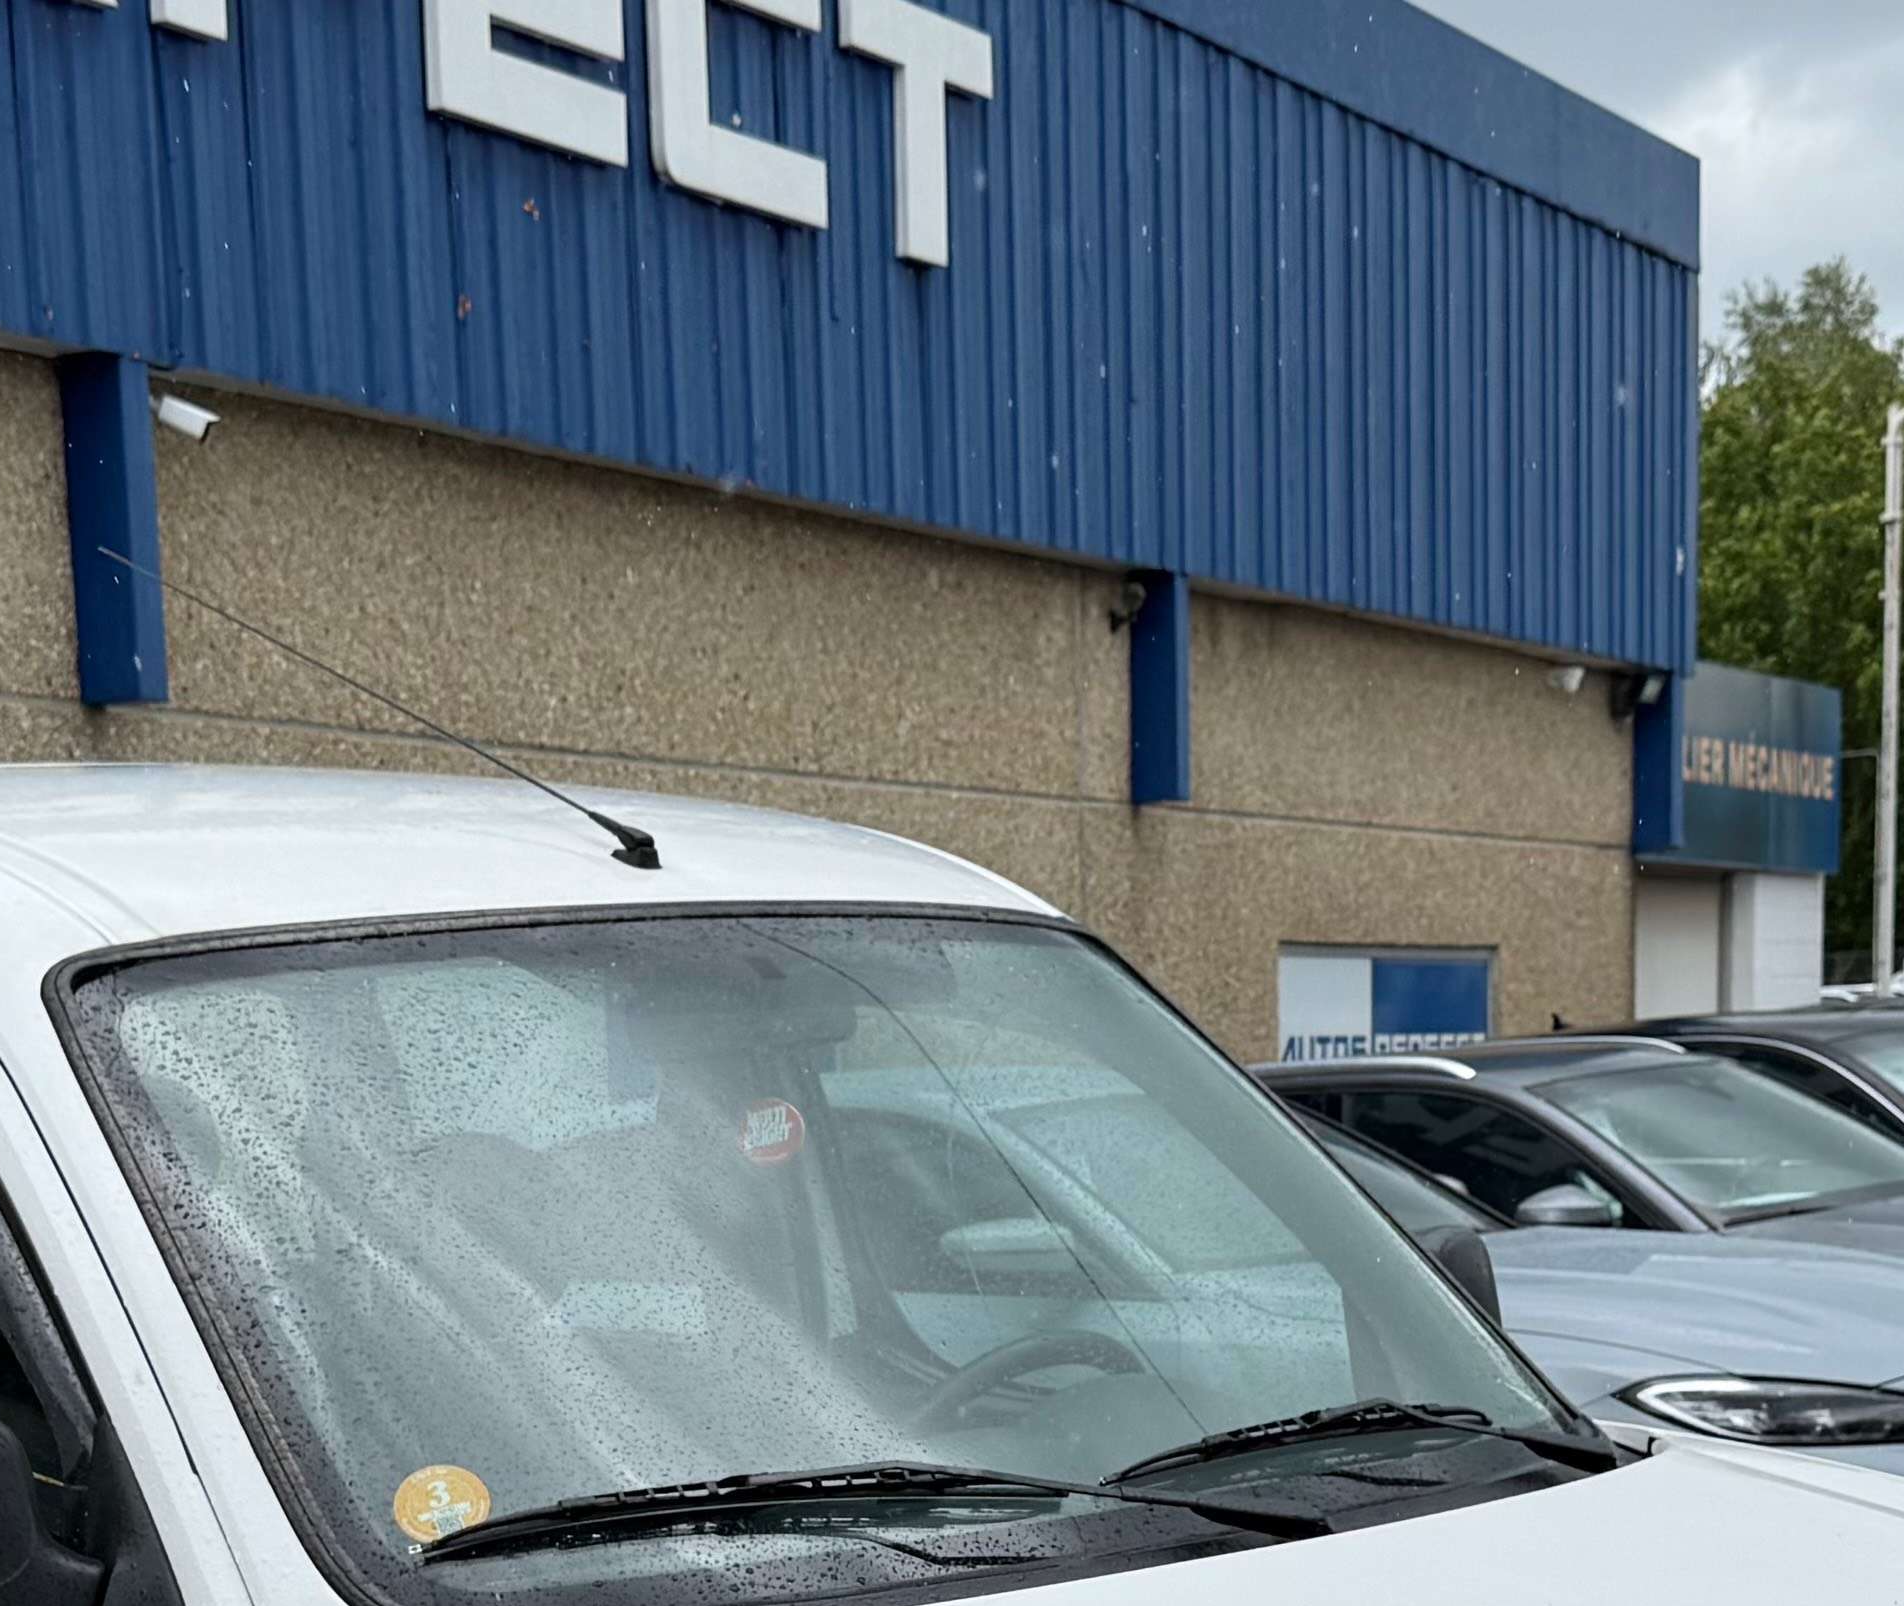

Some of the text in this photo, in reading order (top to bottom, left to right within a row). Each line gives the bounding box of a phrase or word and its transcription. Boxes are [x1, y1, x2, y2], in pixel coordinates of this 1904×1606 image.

[74, 0, 993, 267] ECT
[1729, 731, 1835, 800] MÉCANIQUE
[1375, 1033, 1485, 1054] PERFE
[427, 1480, 451, 1508] 3
